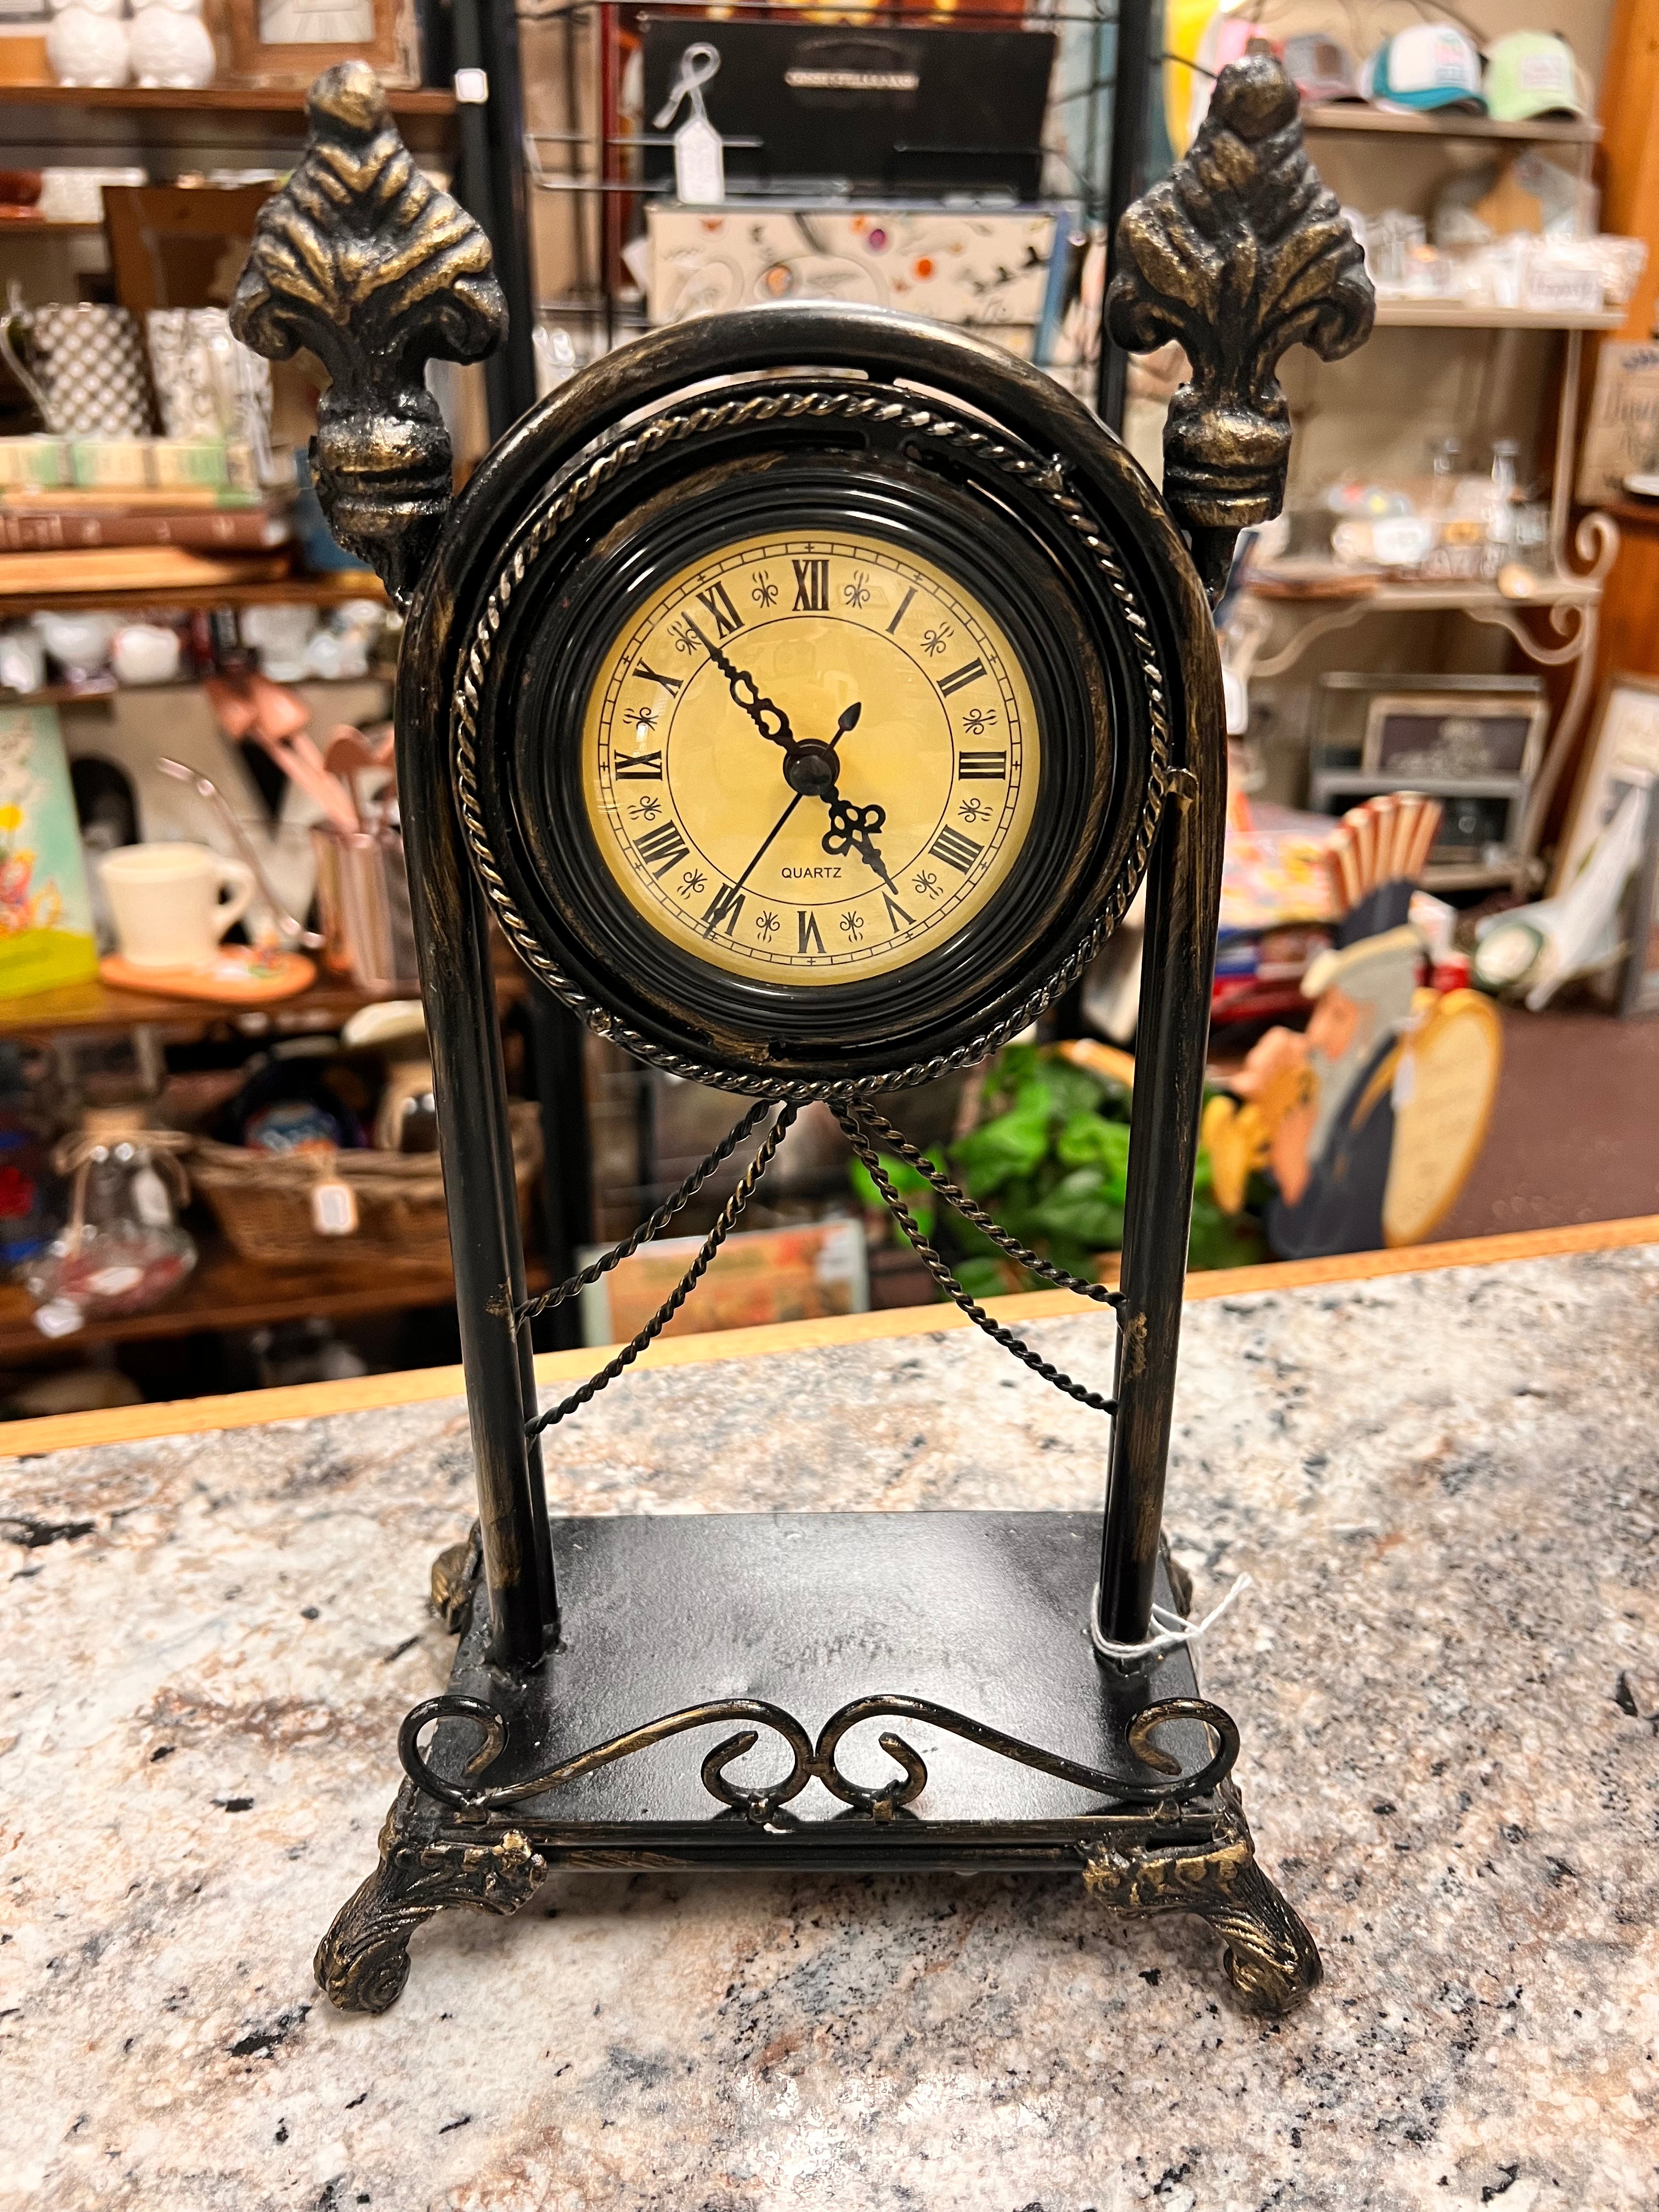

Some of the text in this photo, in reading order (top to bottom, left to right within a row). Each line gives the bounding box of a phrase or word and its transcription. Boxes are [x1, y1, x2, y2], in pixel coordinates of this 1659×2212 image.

[791, 560, 830, 611] XII
[696, 581, 745, 639] XI
[885, 586, 918, 635] I
[632, 657, 684, 698] X
[936, 657, 987, 698] II
[614, 749, 663, 781] IX
[958, 751, 1006, 780] III
[632, 820, 690, 880] VIII
[928, 824, 984, 874] IIII
[781, 867, 842, 878] QUARTZ
[797, 910, 827, 953] VI
[882, 891, 916, 933] V
